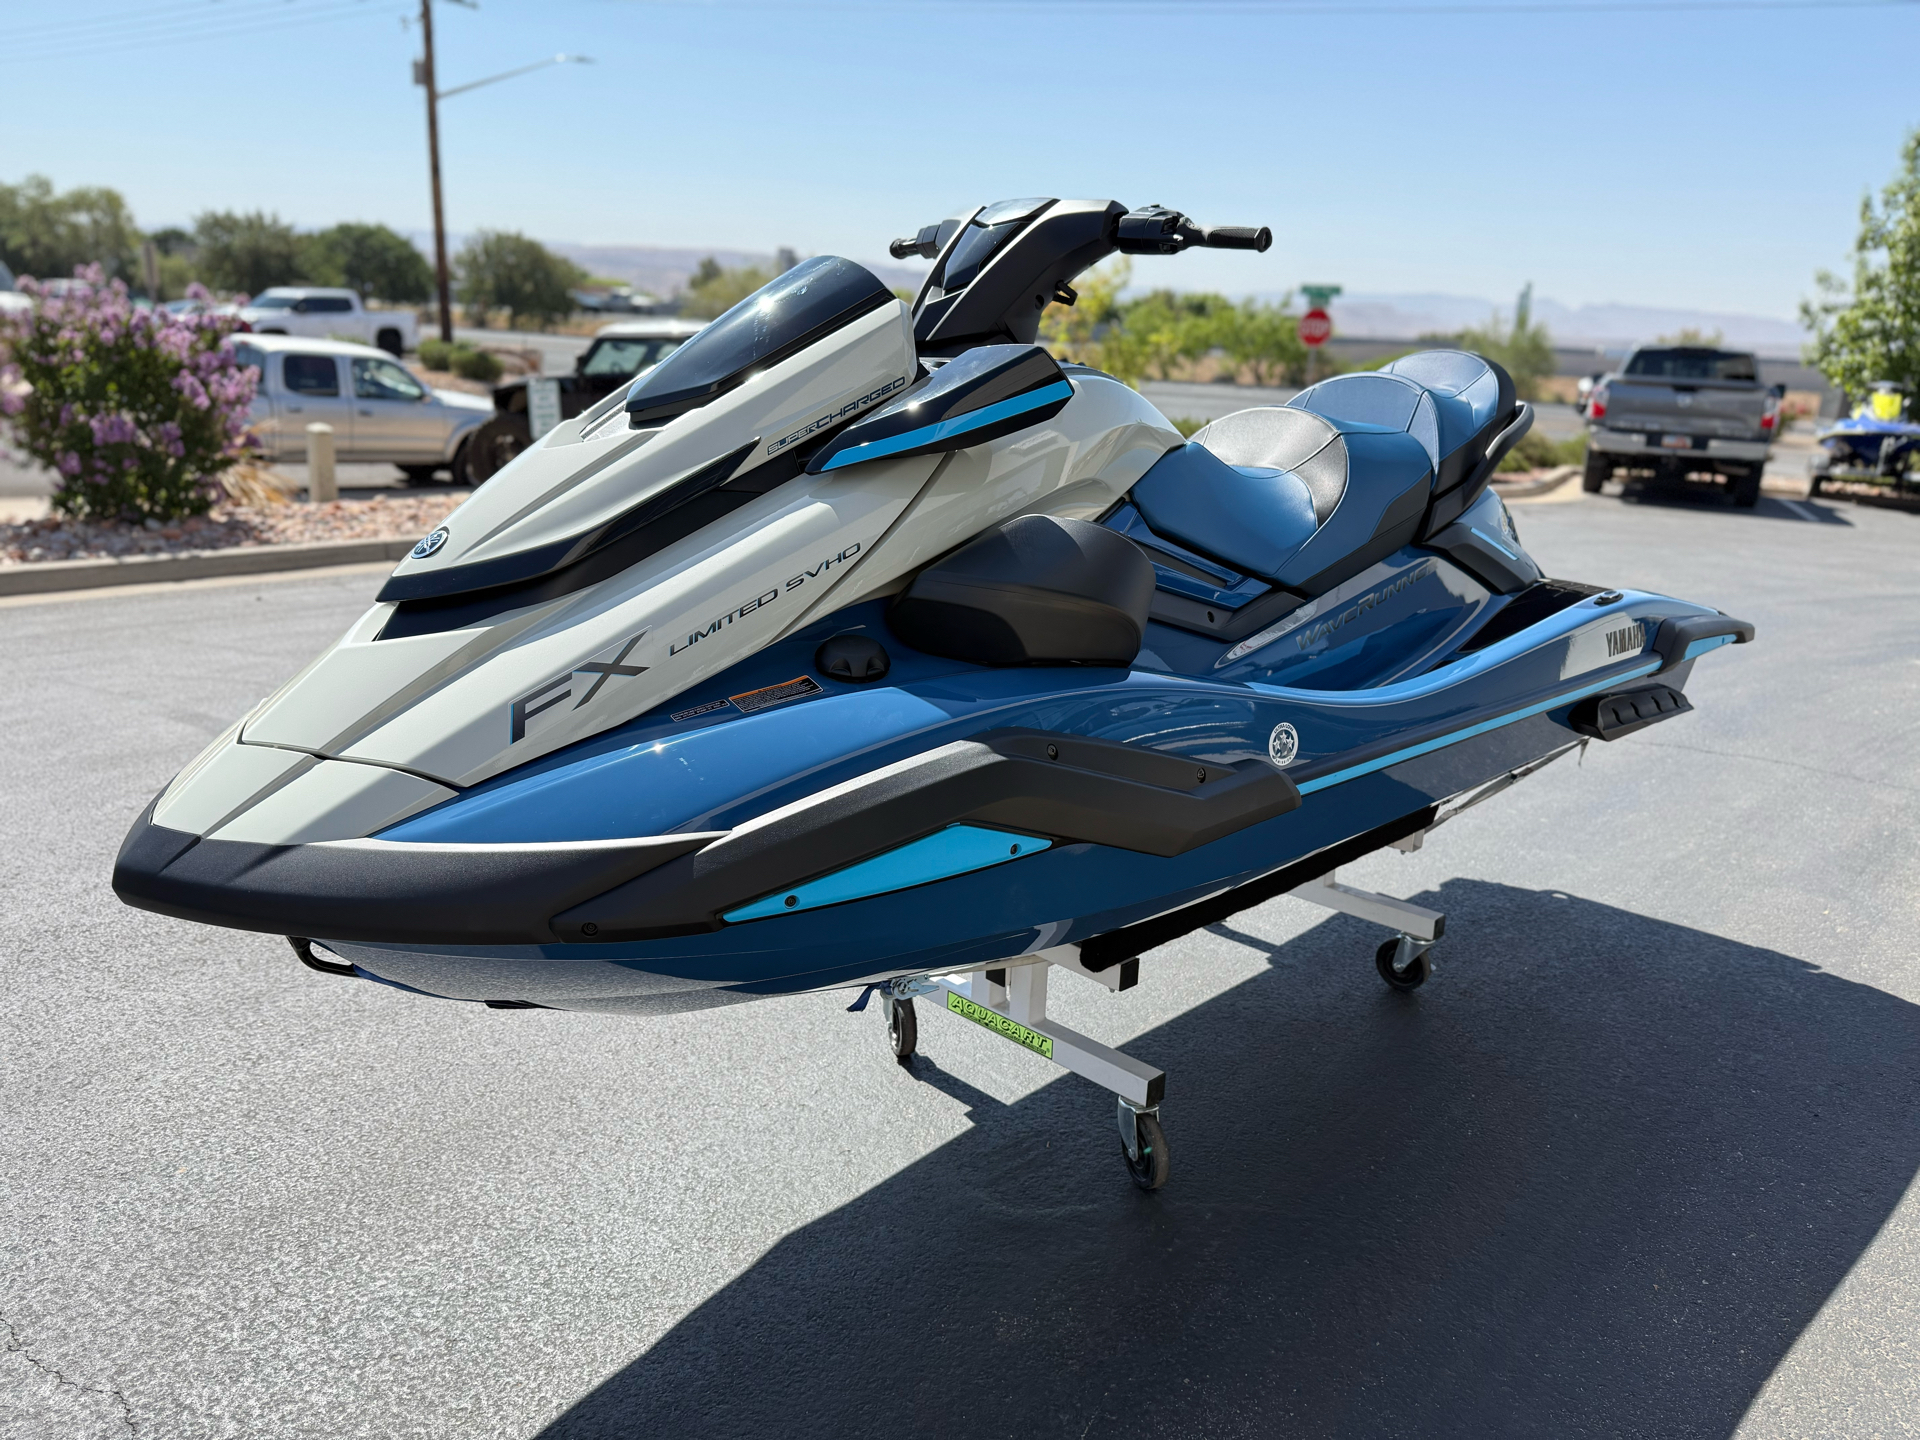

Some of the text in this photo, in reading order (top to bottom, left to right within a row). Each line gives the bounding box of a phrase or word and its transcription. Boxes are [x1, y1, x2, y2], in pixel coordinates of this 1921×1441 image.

[767, 376, 906, 456] SUPERCHARGED
[669, 542, 861, 657] LIMITED SVHO
[1605, 621, 1647, 658] YAMAHA
[510, 629, 651, 745] FX
[952, 996, 1048, 1049] AQUACART
